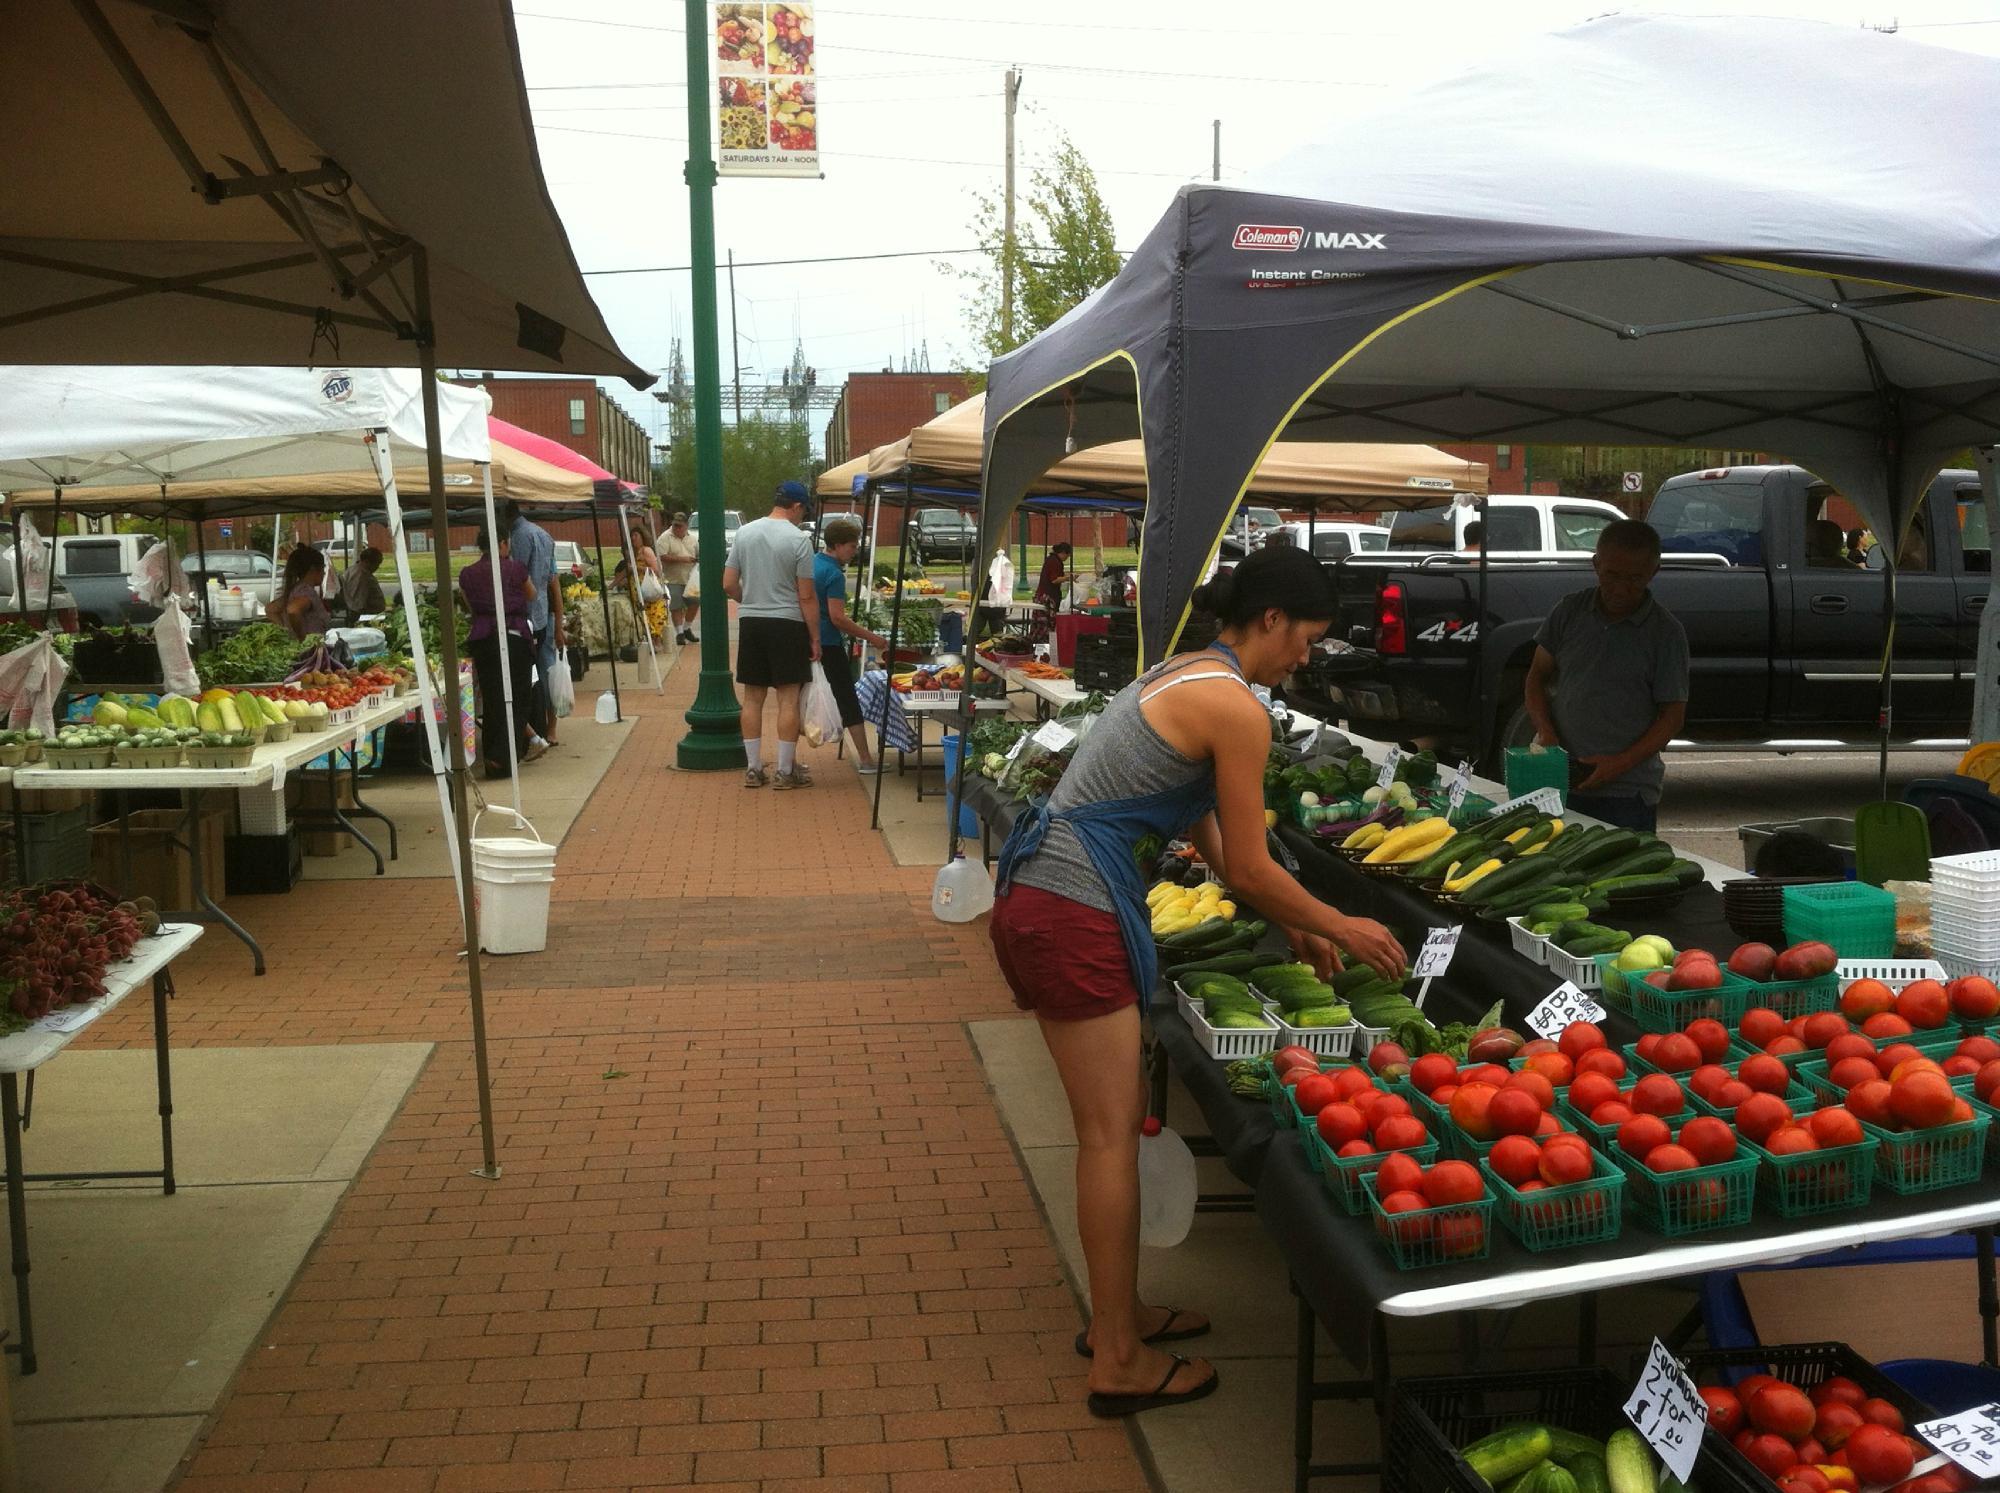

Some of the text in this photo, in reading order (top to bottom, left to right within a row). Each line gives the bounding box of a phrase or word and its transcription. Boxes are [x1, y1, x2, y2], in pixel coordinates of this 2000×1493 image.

[723, 154, 769, 163] SATURDAYS
[771, 155, 788, 163] 7AM
[794, 156, 818, 164] NOON
[1239, 227, 1289, 245] Coleman
[1251, 268, 1307, 280] Instant
[1645, 1365, 1692, 1425] 2 for
